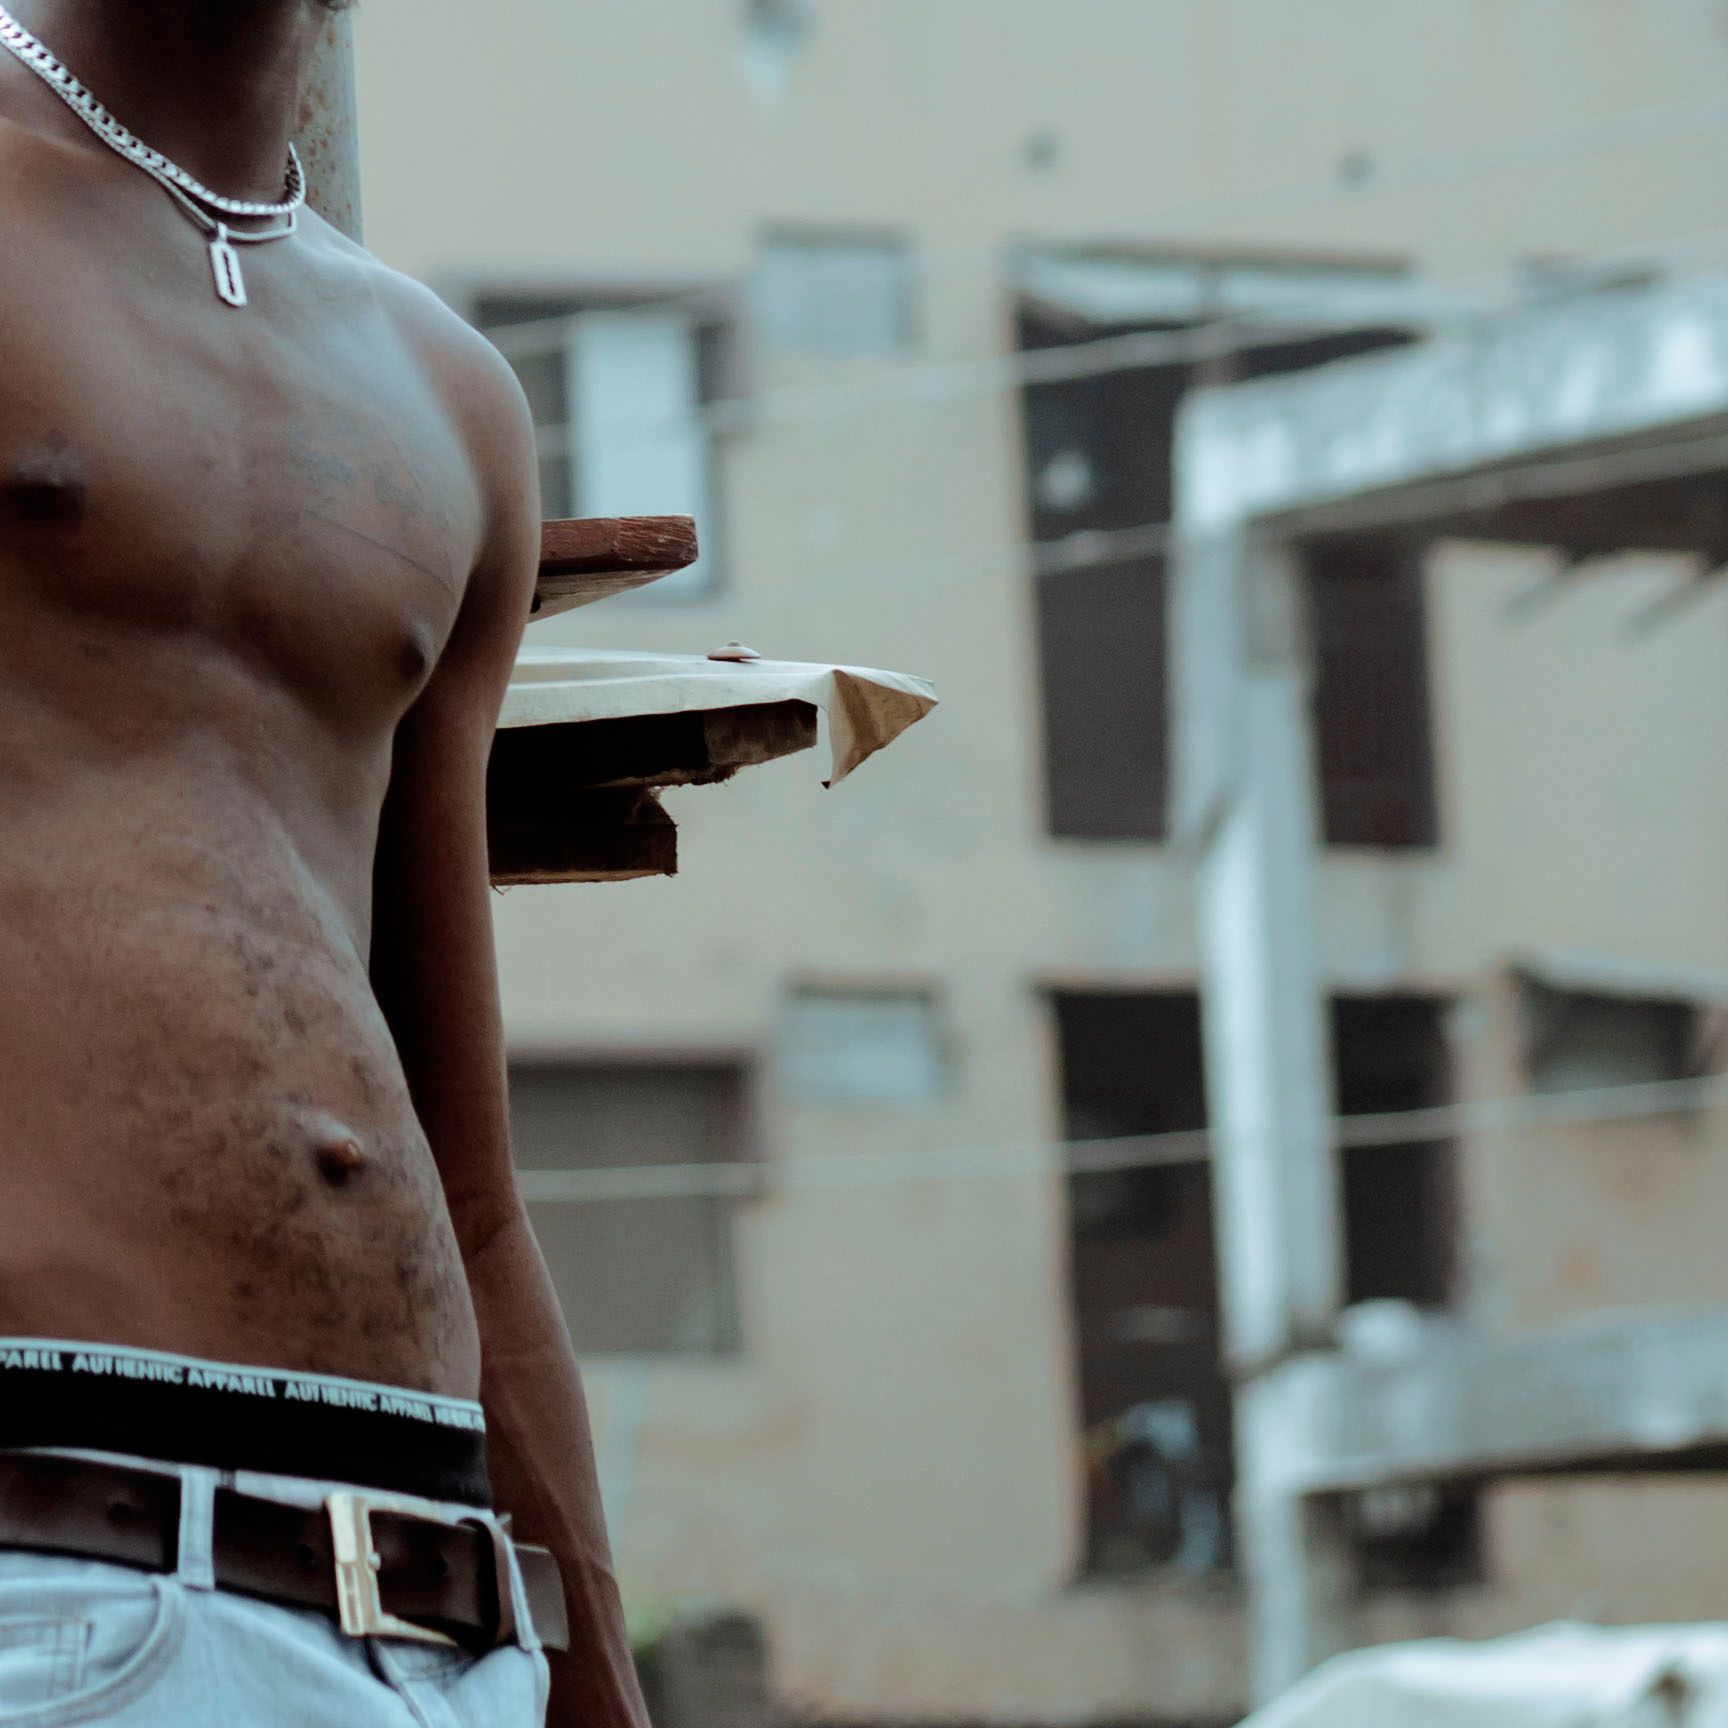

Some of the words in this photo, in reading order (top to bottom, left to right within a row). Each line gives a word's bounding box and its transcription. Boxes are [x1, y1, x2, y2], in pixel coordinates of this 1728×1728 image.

[72, 1352, 183, 1385] AUTHENTIC
[187, 1368, 276, 1398] APPAREL
[284, 1381, 377, 1412] AUTHENTIC
